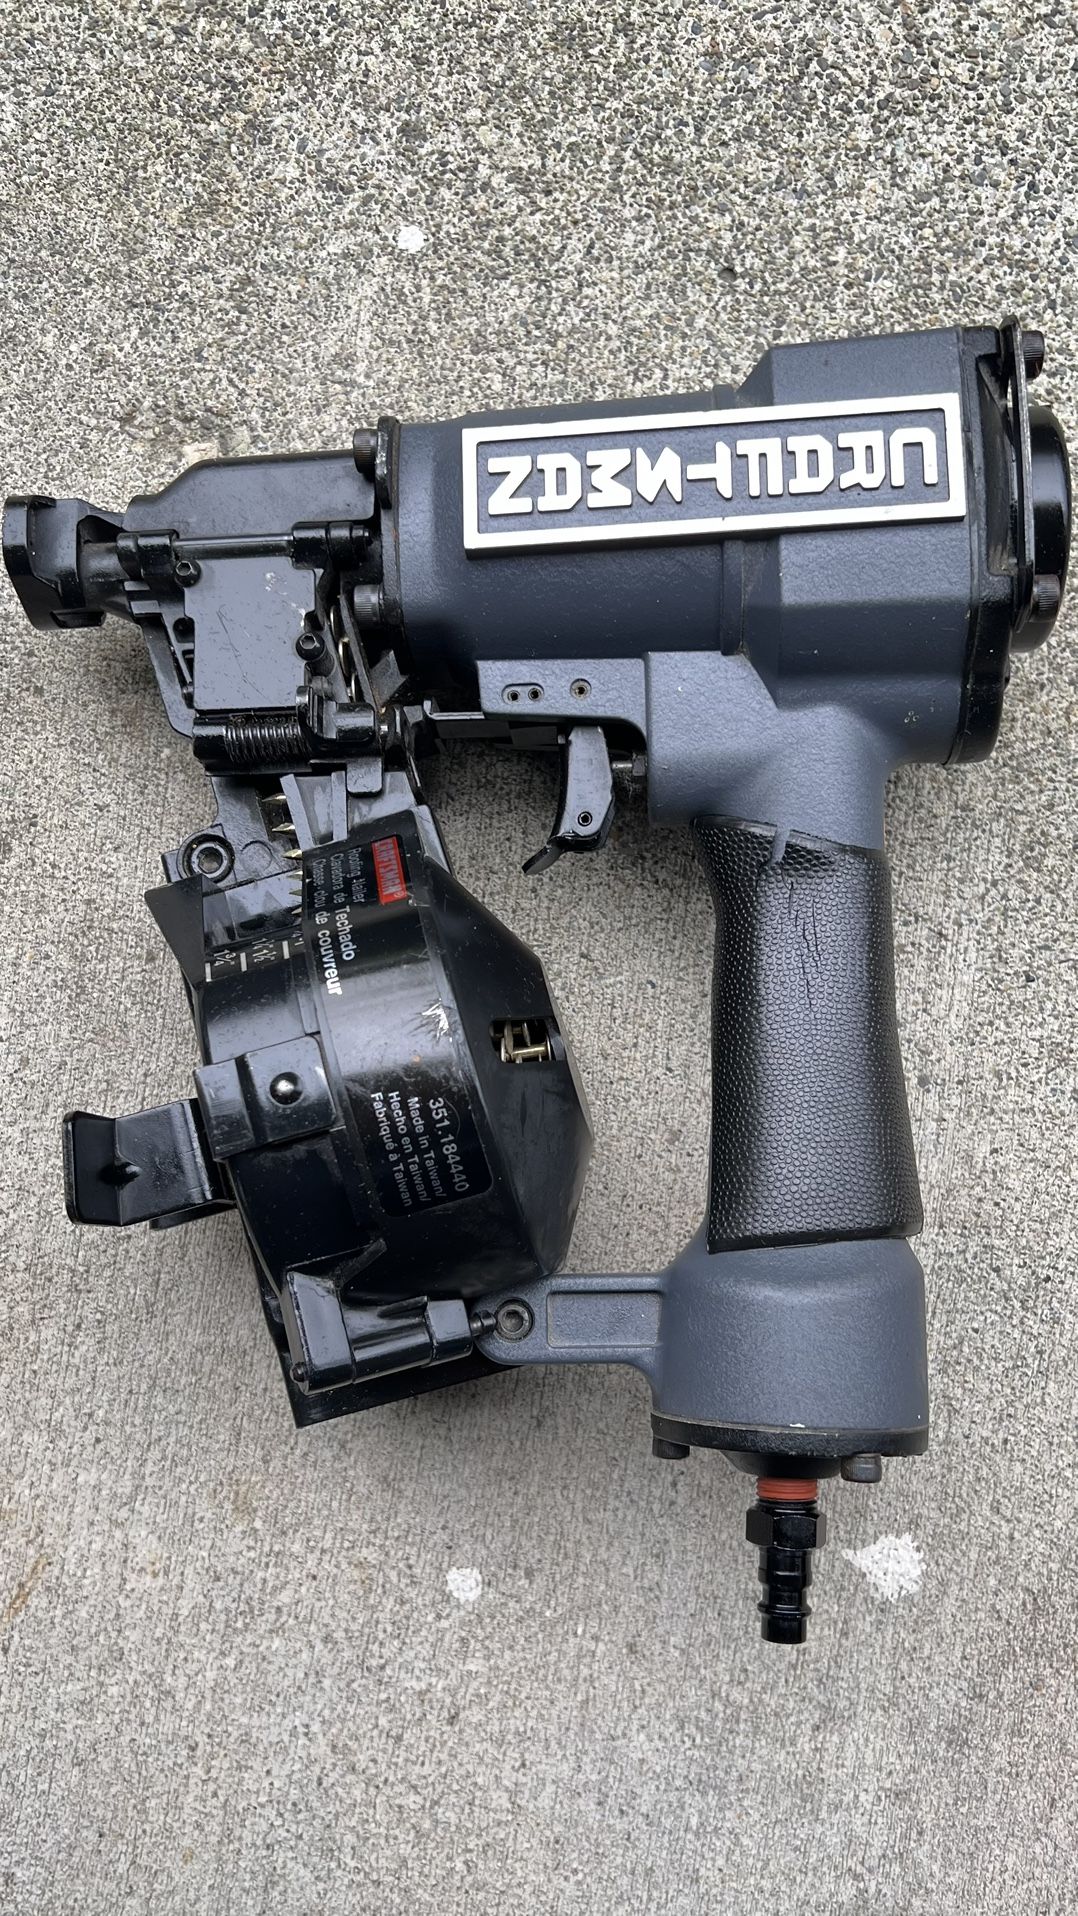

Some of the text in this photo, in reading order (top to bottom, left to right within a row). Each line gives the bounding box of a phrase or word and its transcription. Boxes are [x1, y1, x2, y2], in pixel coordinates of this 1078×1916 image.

[487, 427, 938, 515] CRAFTSMAN
[330, 853, 357, 961] Clavadora de Techado
[347, 847, 364, 878] Roofing
[315, 911, 331, 925] de
[318, 929, 343, 995] couvreur
[371, 1091, 413, 1207] Fabriqué à Taiwan
[388, 1091, 432, 1201] Hecho en Taiwan/
[407, 1096, 447, 1197] Made in Taiwan/
[429, 1097, 470, 1192] 351.184440
